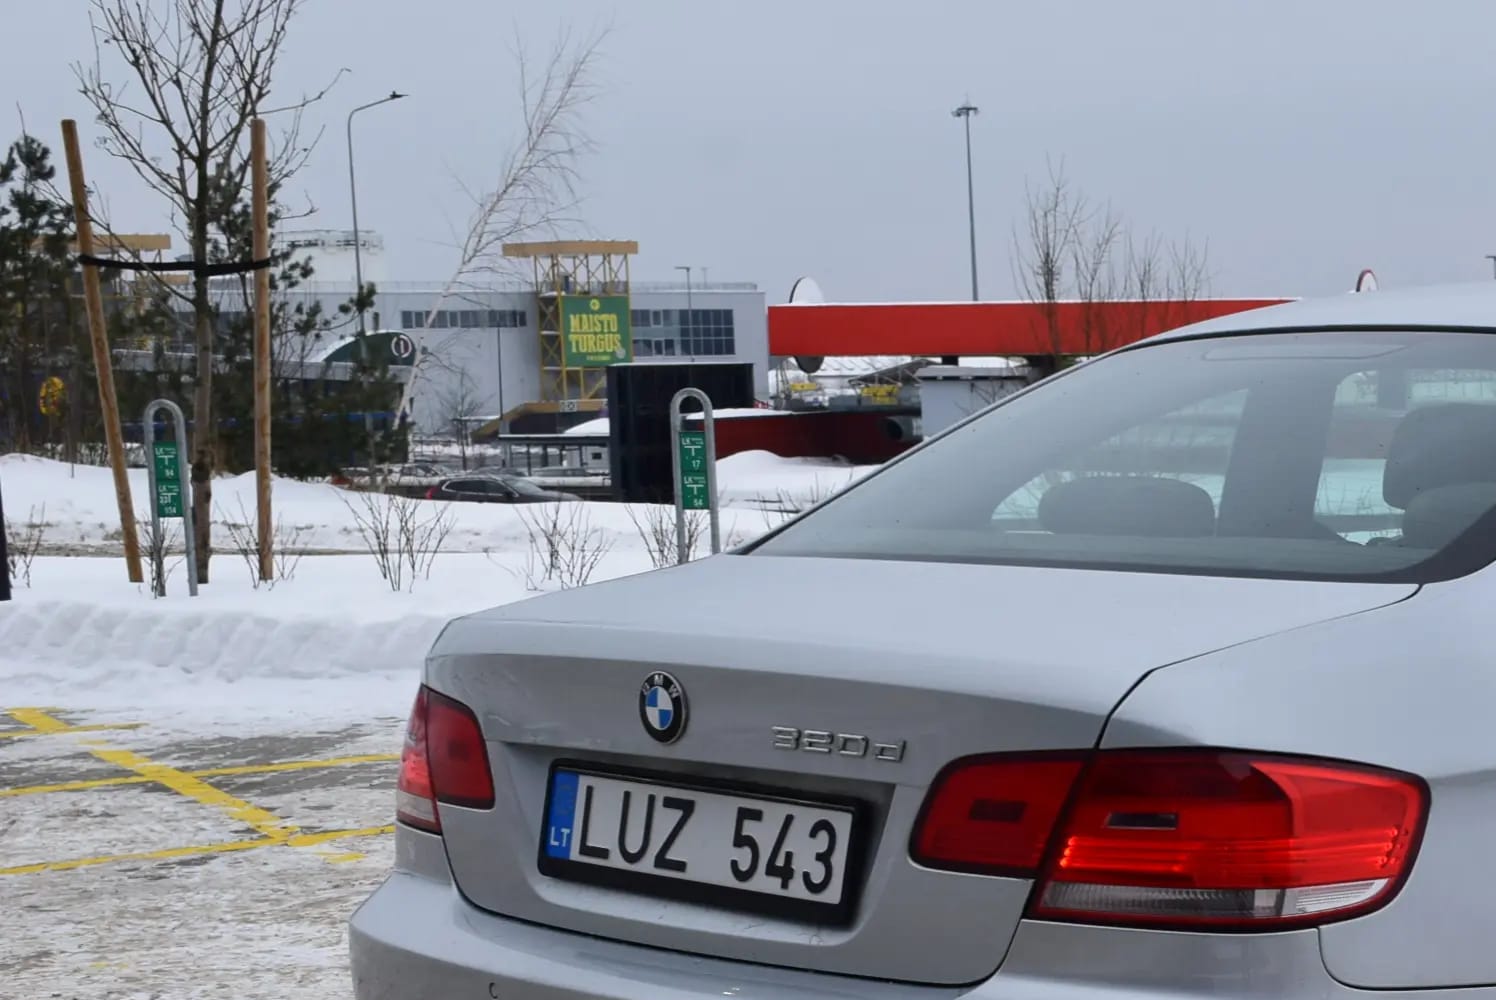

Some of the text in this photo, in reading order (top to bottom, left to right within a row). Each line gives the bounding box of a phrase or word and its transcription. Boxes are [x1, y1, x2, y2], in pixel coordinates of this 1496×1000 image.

[569, 313, 618, 332] MAISTO
[568, 334, 622, 352] TURGUS
[641, 674, 680, 699] BMW
[771, 726, 906, 763] 320d
[549, 826, 571, 848] LT
[578, 785, 837, 895] LUZ 543
